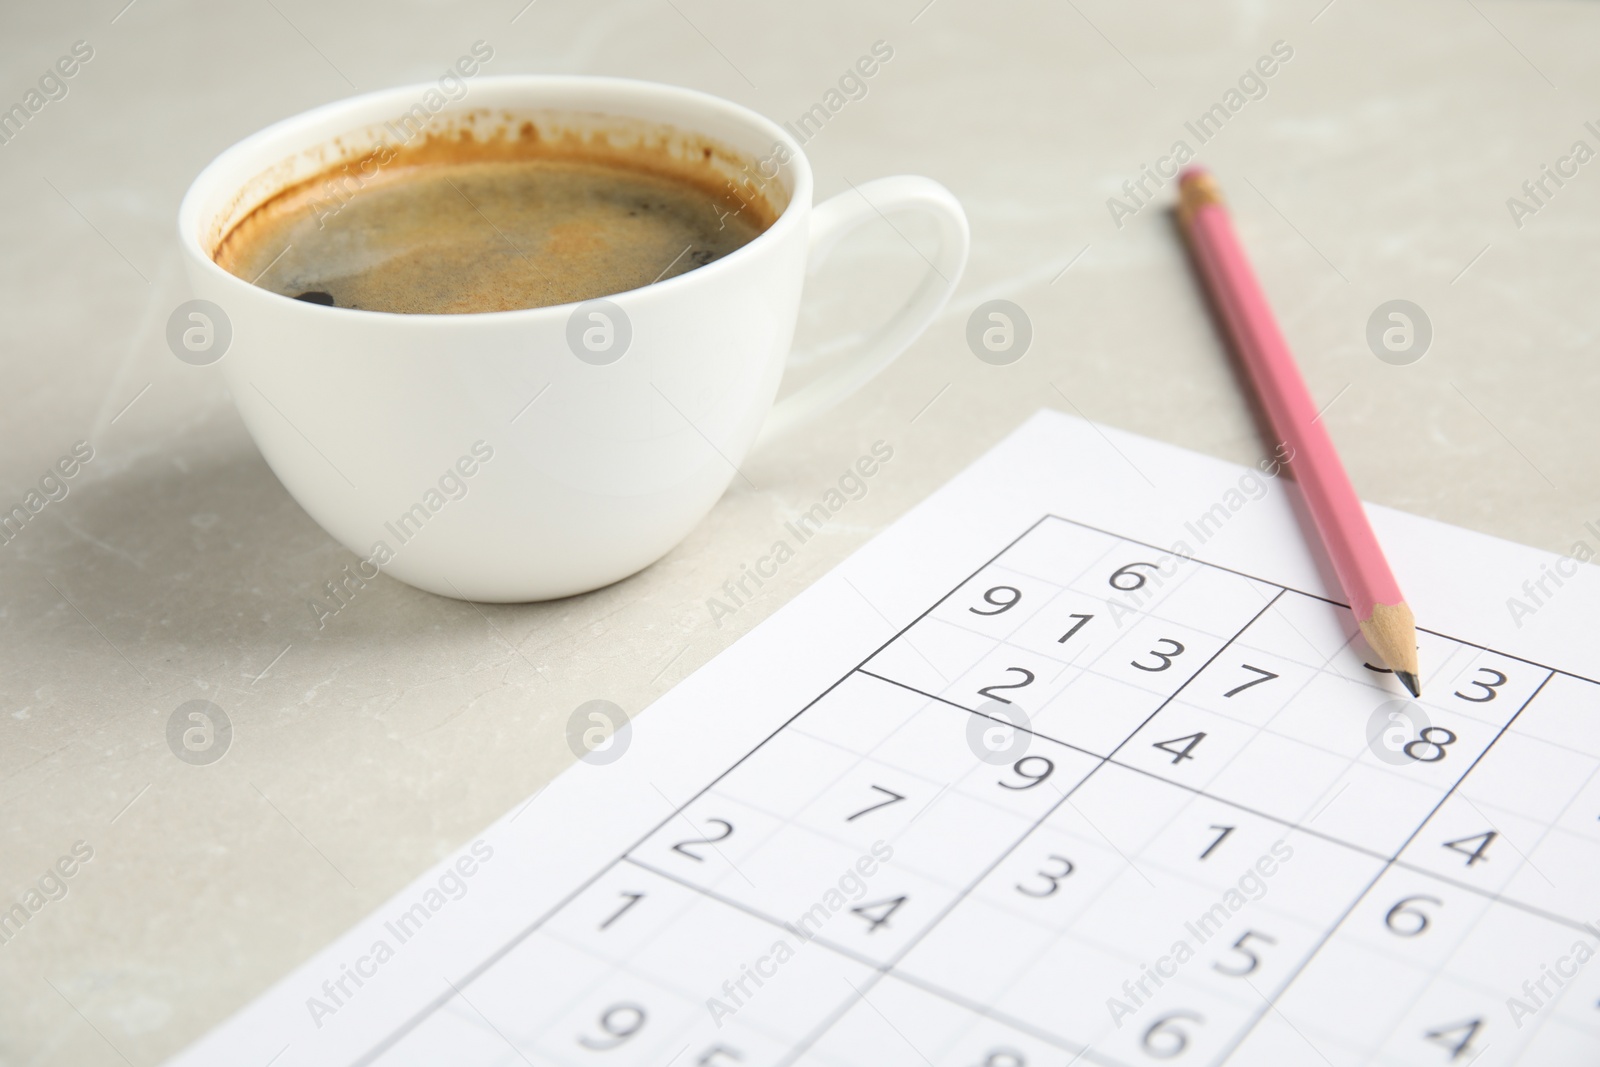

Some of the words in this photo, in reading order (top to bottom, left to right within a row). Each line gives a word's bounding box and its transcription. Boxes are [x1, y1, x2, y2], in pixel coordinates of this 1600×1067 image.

[1109, 563, 1159, 591] 6
[969, 586, 1022, 616] 9
[1058, 614, 1094, 643] 1
[1131, 638, 1185, 672] 3
[977, 667, 1035, 704] 2
[1223, 664, 1279, 698] 7
[1454, 668, 1507, 702] 3
[1152, 732, 1207, 764] 4
[1403, 727, 1457, 762] 8
[998, 756, 1055, 790] 9
[847, 785, 905, 821] 7
[671, 818, 734, 862] 2
[1200, 826, 1235, 859] 1
[1443, 831, 1498, 866] 4
[1016, 856, 1074, 897] 3
[601, 893, 644, 929] 1
[851, 896, 907, 932] 4
[1385, 895, 1444, 938] 6
[1211, 929, 1278, 978] 5
[576, 1003, 648, 1052] 9
[1140, 1009, 1205, 1060] 6
[1426, 1018, 1483, 1060] 4
